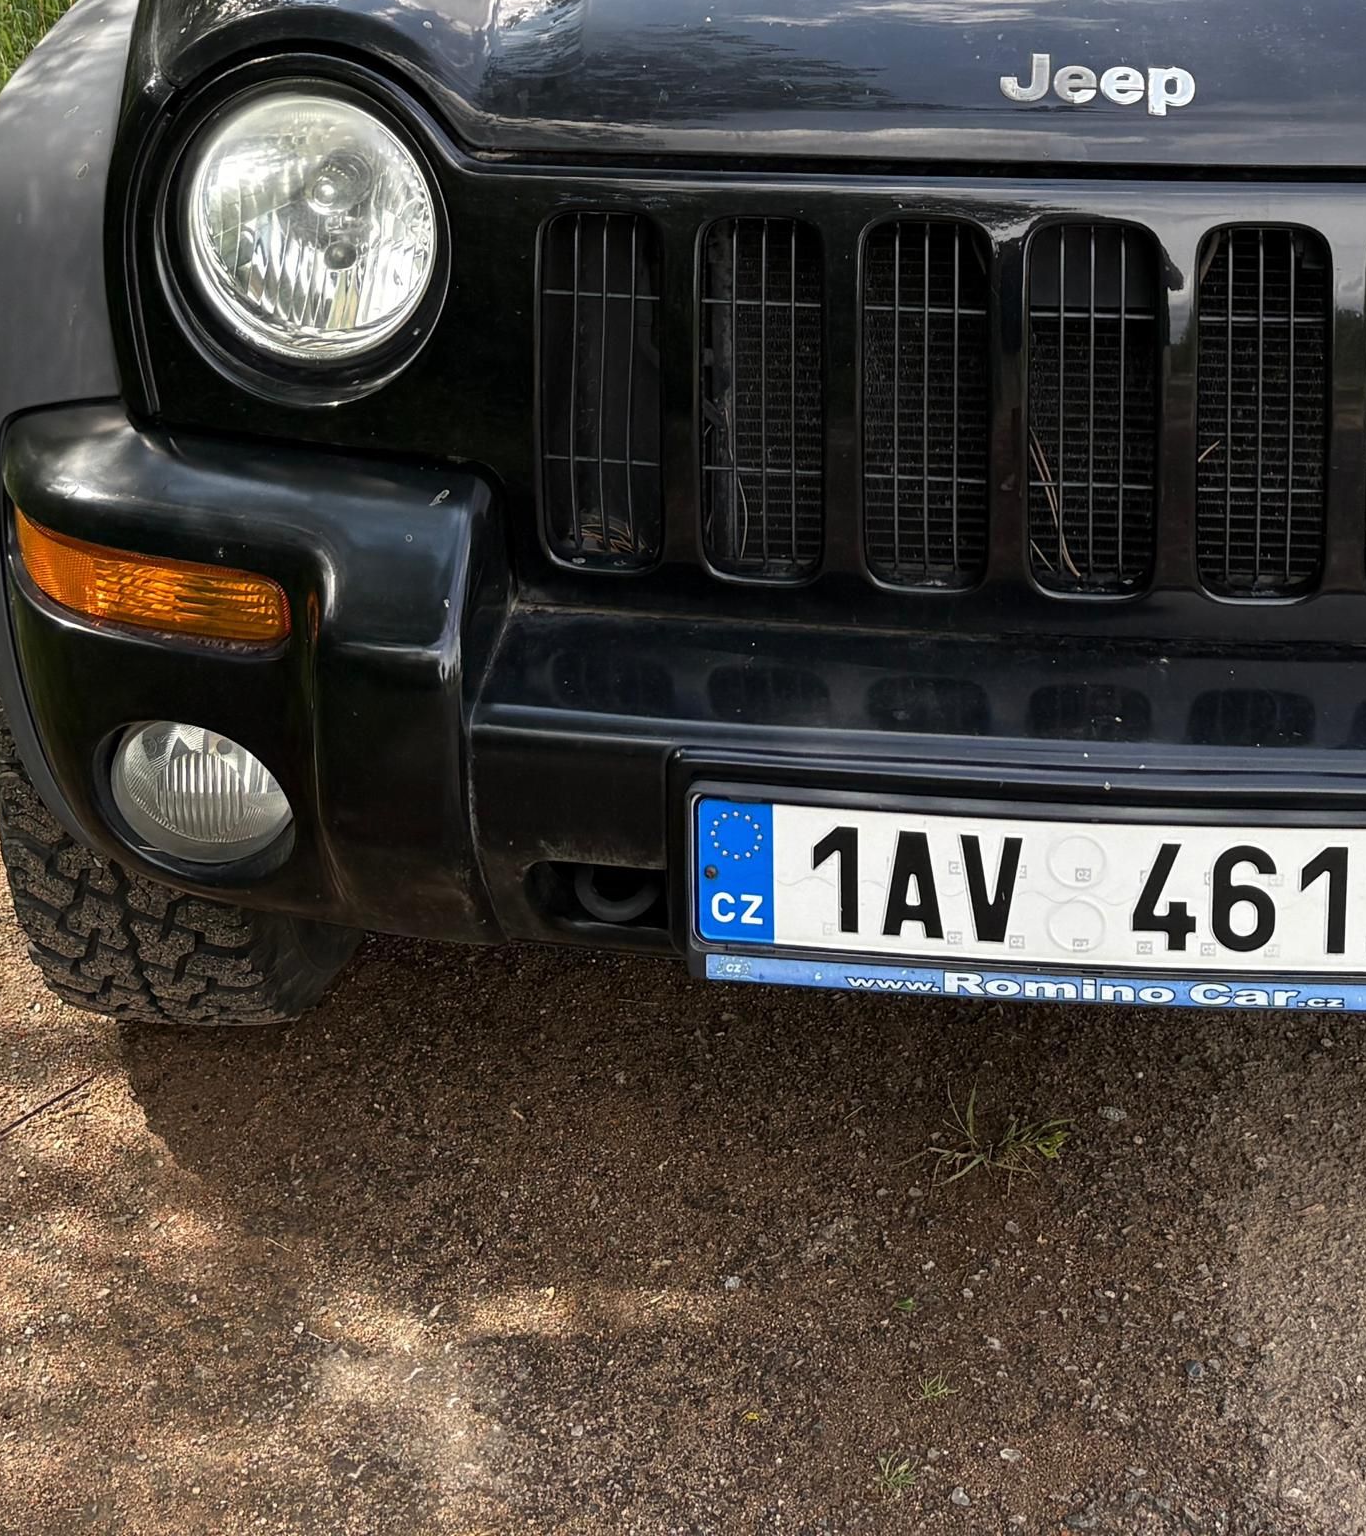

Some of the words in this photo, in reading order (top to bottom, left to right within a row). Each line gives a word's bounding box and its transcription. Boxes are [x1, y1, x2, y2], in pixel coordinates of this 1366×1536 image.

[1000, 53, 1195, 116] Jeep
[711, 891, 764, 925] CZ
[812, 825, 1023, 943] 1AV
[846, 970, 1176, 1005] www.Romino
[1189, 982, 1345, 1009] Car.cz
